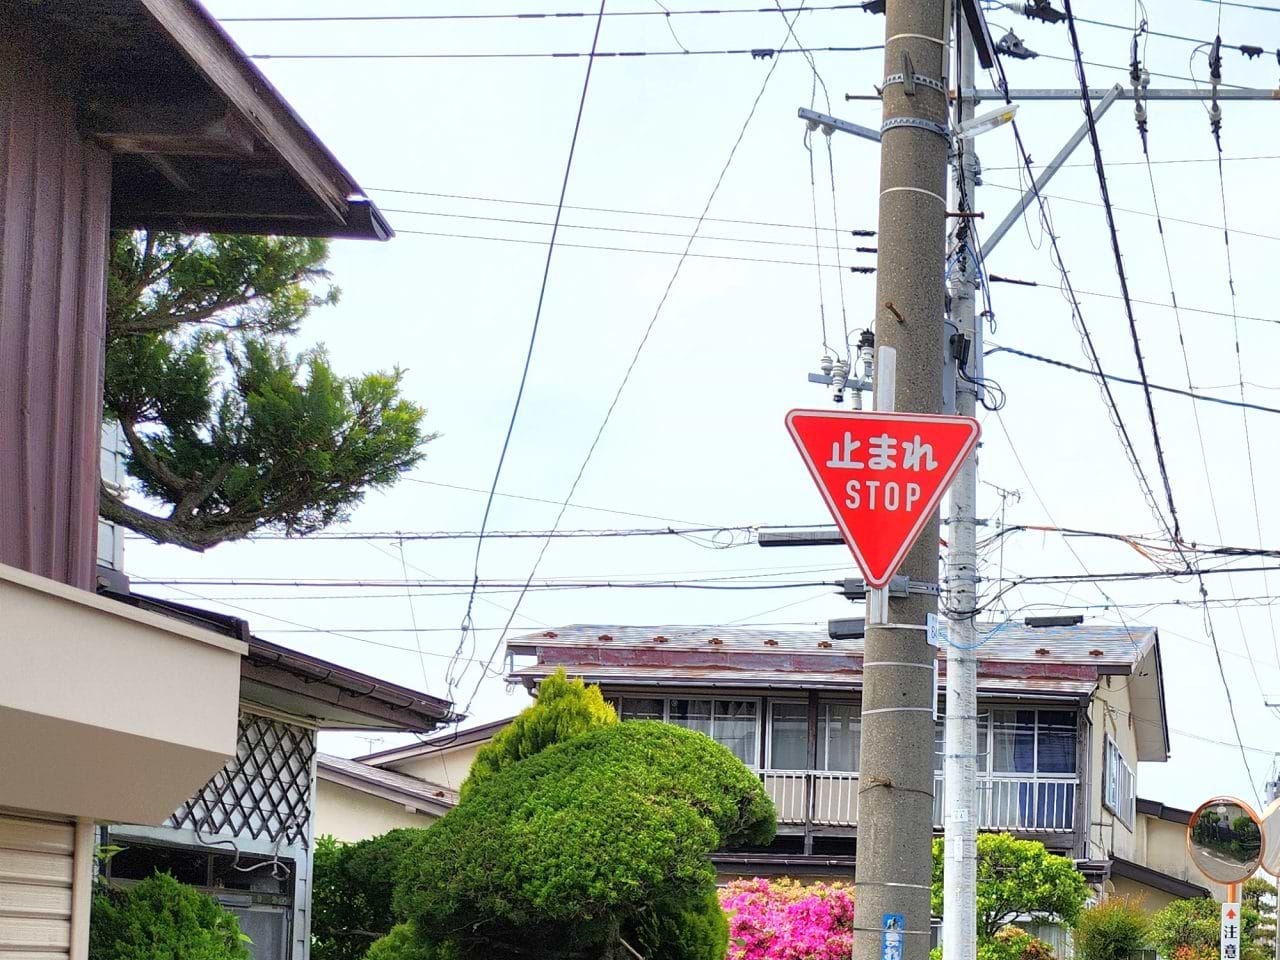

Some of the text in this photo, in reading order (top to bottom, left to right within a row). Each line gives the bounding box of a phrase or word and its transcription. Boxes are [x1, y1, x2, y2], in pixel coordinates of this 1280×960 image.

[826, 431, 939, 472] 止まれ
[845, 479, 922, 512] STOP
[1224, 924, 1238, 959] 注意
